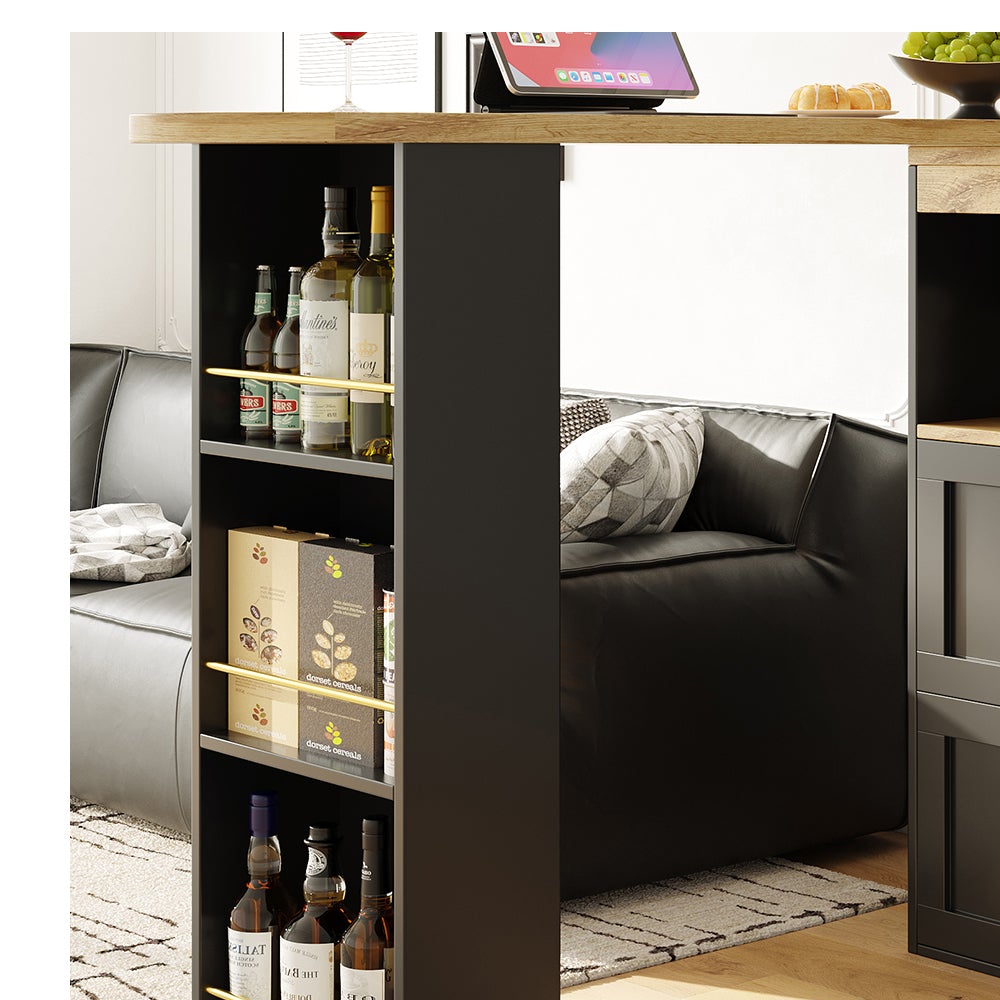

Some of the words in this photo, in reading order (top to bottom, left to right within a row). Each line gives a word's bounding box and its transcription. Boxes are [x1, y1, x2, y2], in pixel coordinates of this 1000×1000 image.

[306, 673, 332, 686] dorset
[332, 680, 362, 694] cereals
[306, 739, 332, 754] dorset
[332, 744, 362, 761] cereals
